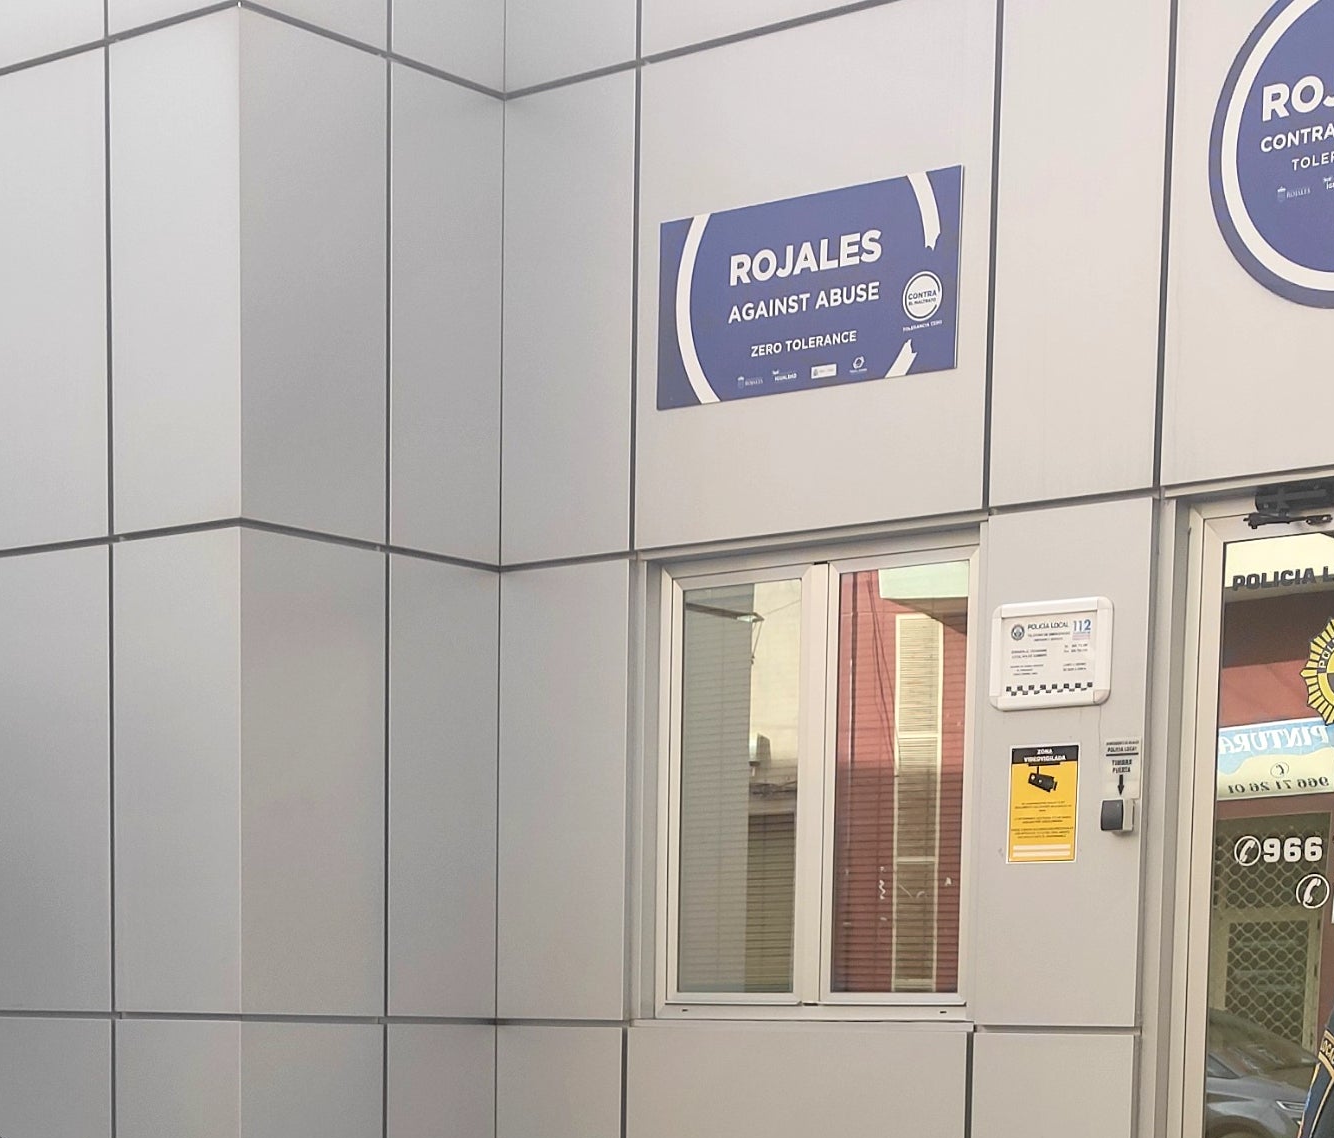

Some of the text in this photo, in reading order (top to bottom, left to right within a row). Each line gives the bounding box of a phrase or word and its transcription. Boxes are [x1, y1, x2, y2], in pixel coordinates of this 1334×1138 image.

[729, 229, 883, 287] ROJALES
[728, 281, 880, 325] AGAINST ABUSE
[907, 289, 937, 301] CONTRA
[750, 329, 858, 358] ZERO TOLERANCE
[1232, 567, 1316, 592] POLICIA
[1073, 619, 1092, 632] 112
[1262, 836, 1324, 863] 966
